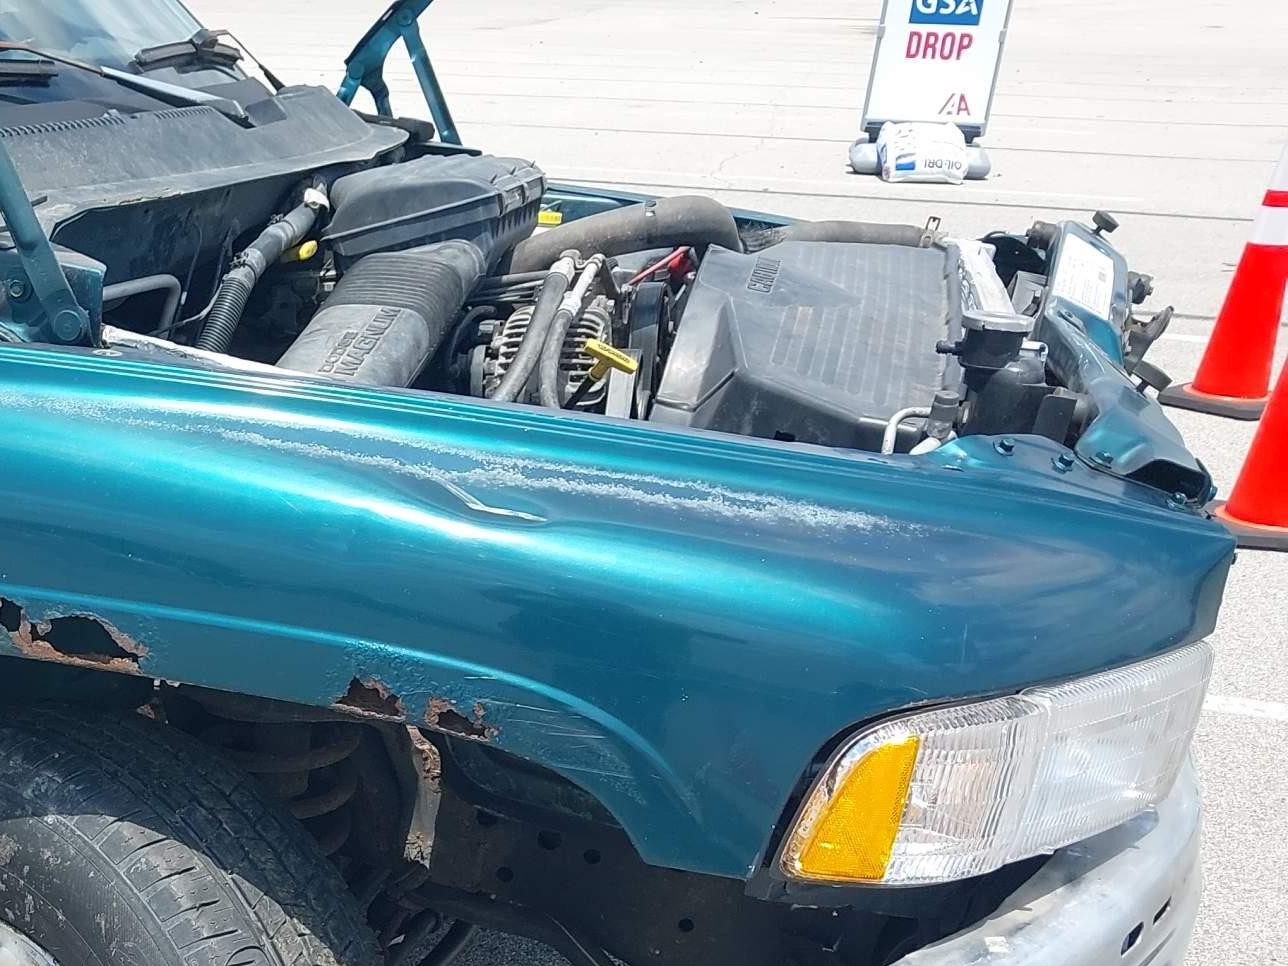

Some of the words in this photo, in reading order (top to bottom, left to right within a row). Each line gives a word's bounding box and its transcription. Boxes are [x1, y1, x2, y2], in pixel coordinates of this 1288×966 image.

[905, 31, 973, 60] DROP
[318, 331, 358, 373] DODGE
[334, 308, 401, 376] MAGNUM
